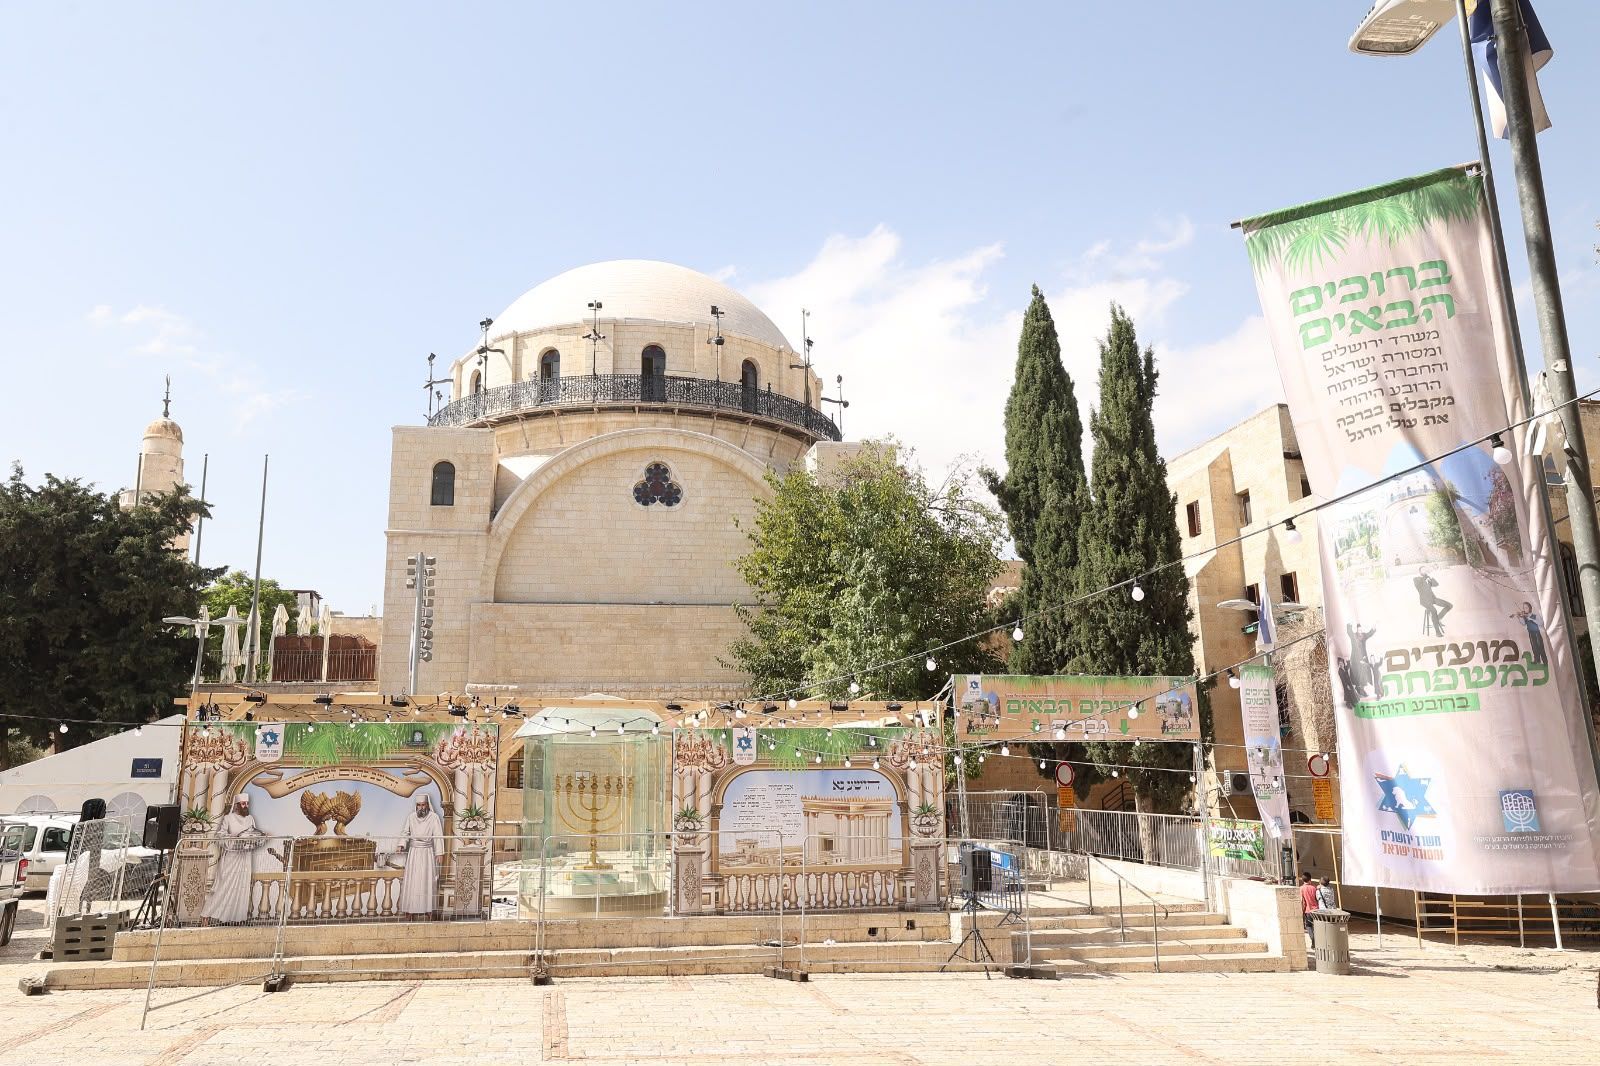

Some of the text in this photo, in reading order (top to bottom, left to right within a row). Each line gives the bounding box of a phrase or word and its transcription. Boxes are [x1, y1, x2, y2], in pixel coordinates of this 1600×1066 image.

[1289, 259, 1453, 317] ברוכים
[1299, 293, 1456, 350] הבאים
[1322, 330, 1440, 362] משרד ירושלים
[1323, 346, 1442, 378] ומסורת ישראל
[1327, 362, 1449, 395] והחברה לפיתוח
[1340, 380, 1441, 408] הרובע היהודי
[1336, 395, 1456, 428] מקבלים בברכה
[1345, 413, 1449, 442] את עולי הרגל
[1384, 639, 1520, 672] מועדים
[1381, 651, 1549, 697] למשפחה
[1006, 699, 1073, 714] הבאים
[1360, 696, 1471, 716] ברובע היהודי
[1381, 830, 1441, 846] משרד ירושלים
[1382, 842, 1444, 861] ומסורת ישראל
